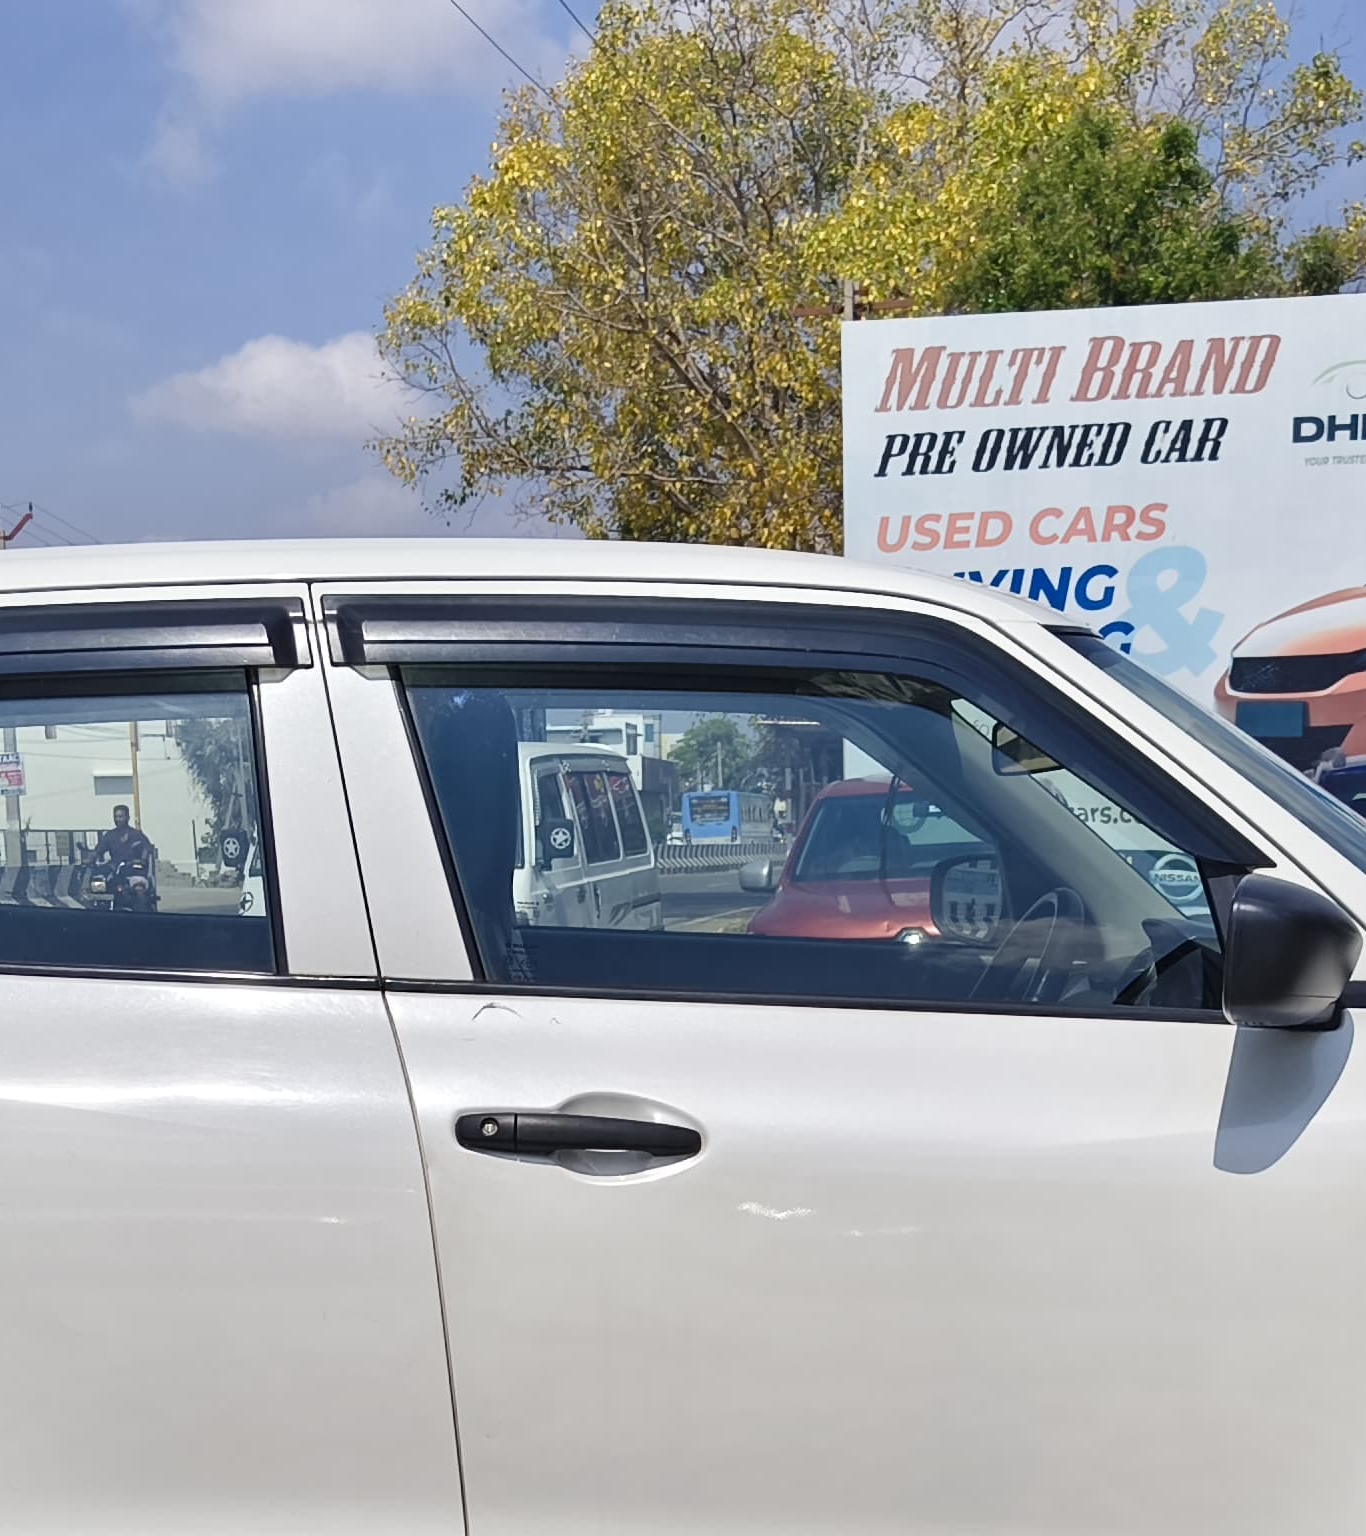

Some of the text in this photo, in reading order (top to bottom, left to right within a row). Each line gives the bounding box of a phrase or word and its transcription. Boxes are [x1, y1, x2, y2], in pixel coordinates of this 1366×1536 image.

[874, 334, 1281, 413] MULTI BRAND
[874, 417, 1229, 478] PRE OWNED CAR
[1304, 456, 1330, 467] YOUR
[876, 503, 1169, 553] USED CARS
